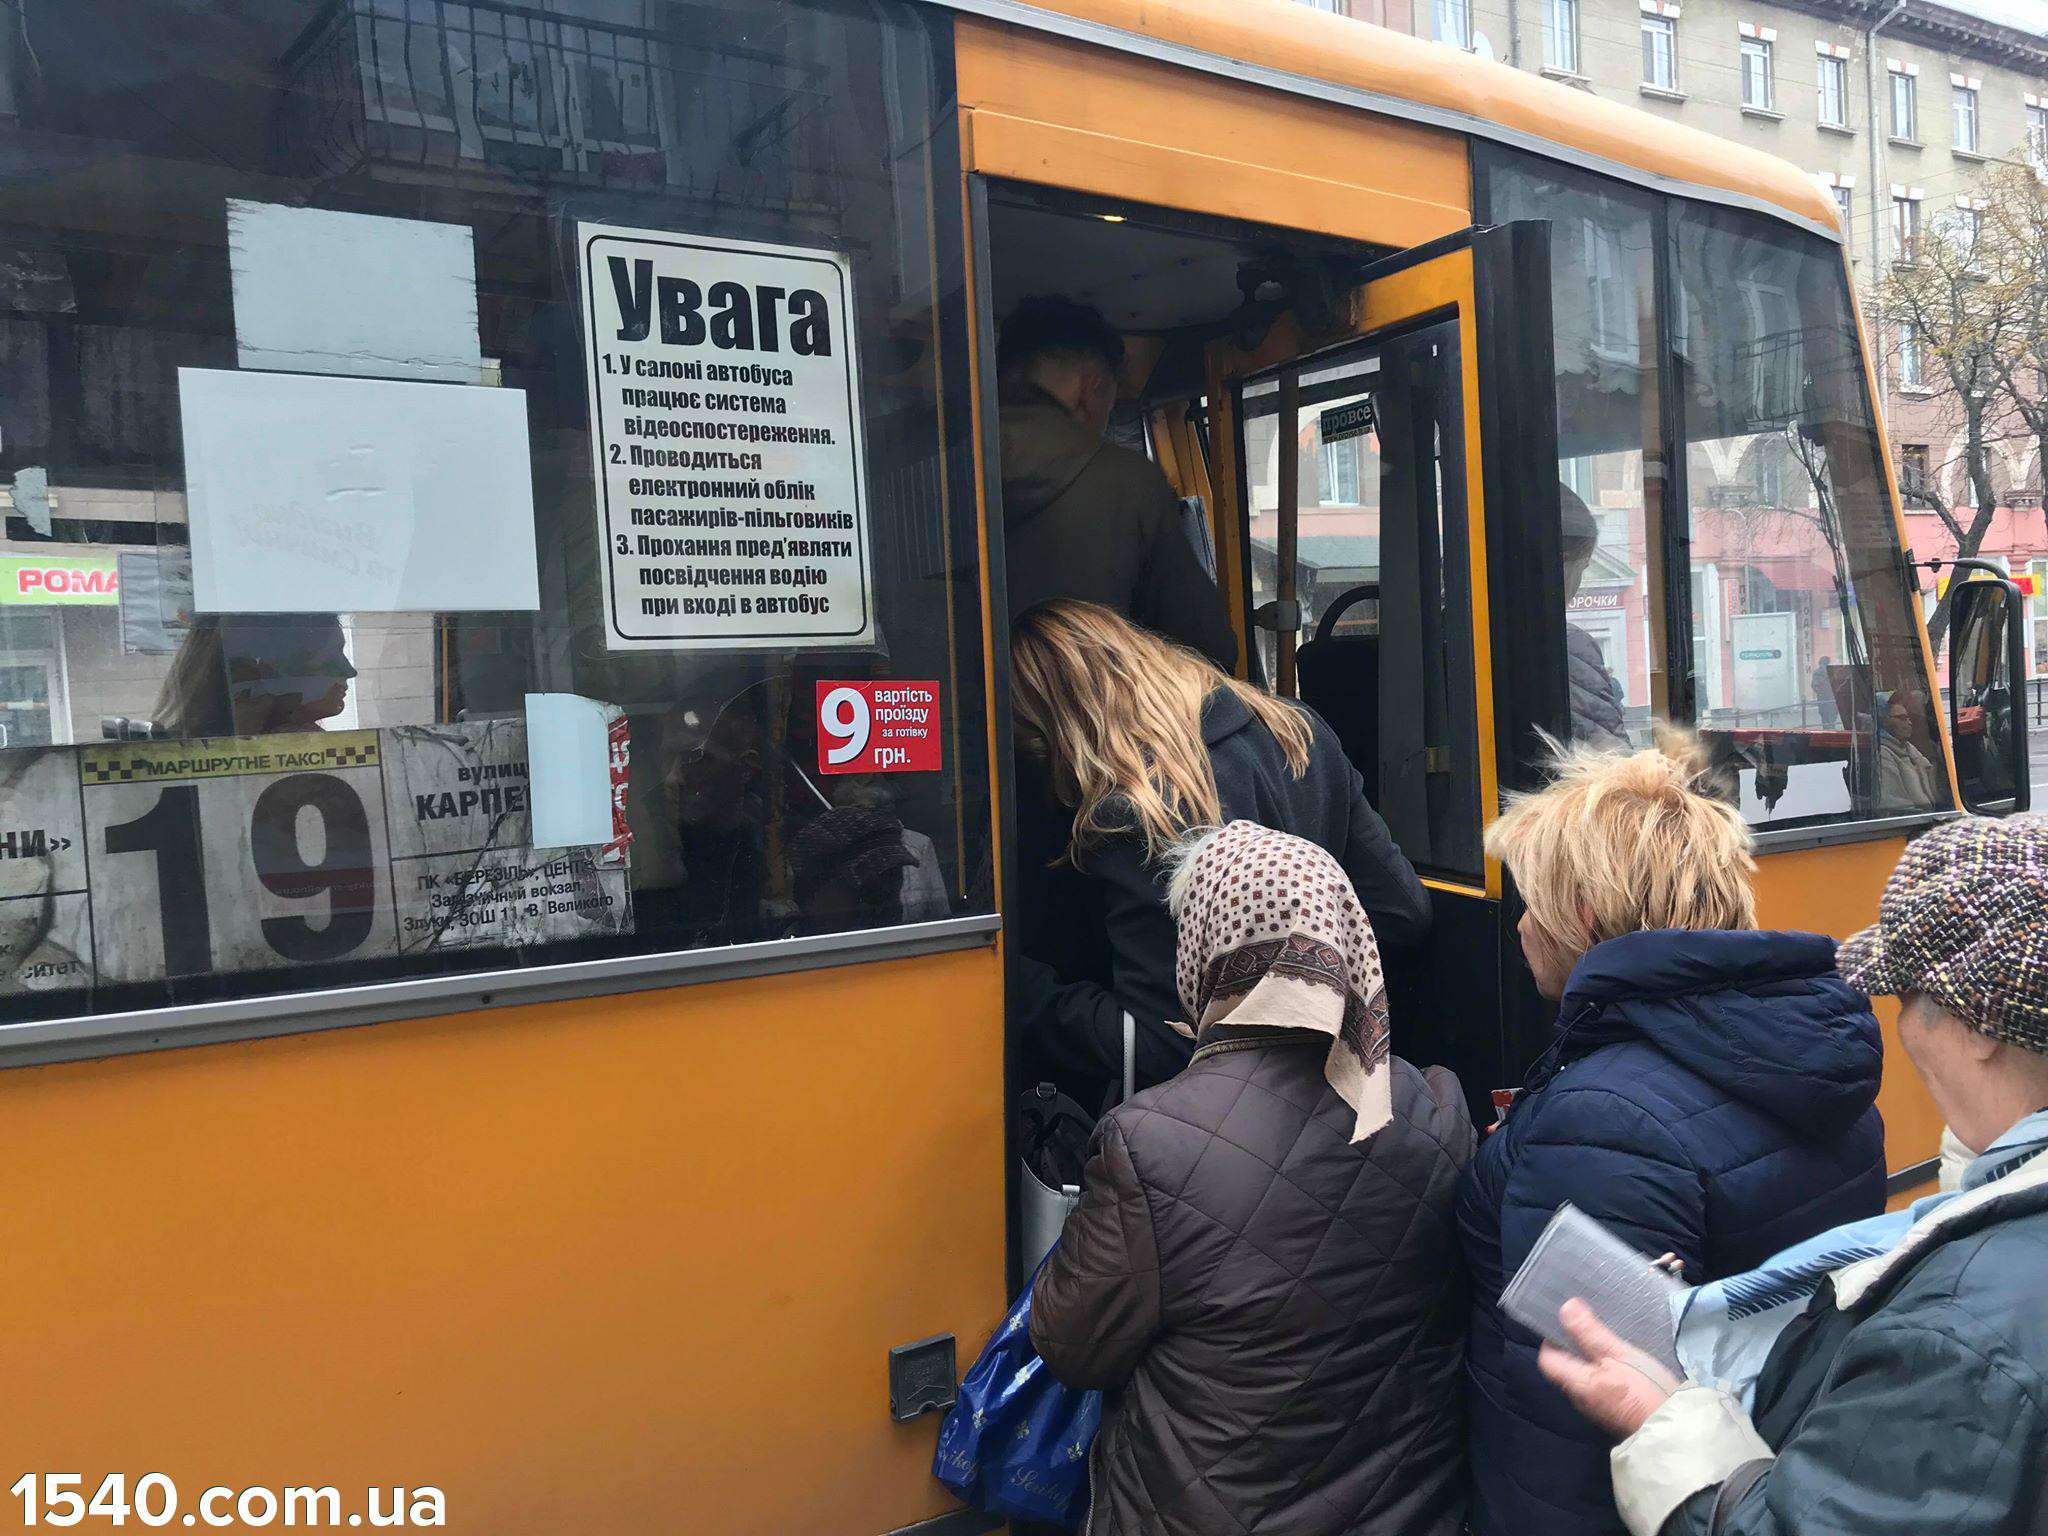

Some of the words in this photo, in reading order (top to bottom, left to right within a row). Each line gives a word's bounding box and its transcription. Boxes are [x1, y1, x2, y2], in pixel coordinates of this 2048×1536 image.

[606, 255, 832, 358] Увага
[602, 353, 617, 375] 1.
[620, 354, 631, 375] У
[636, 358, 703, 381] салоні
[706, 364, 794, 386] автобуса
[622, 387, 701, 411] працює
[706, 394, 787, 414] система
[624, 416, 836, 445] відеоспостереження.
[609, 443, 627, 465] 2.
[630, 444, 762, 471] Проводиться
[628, 477, 760, 500] електронний
[764, 480, 816, 501] облік
[630, 507, 854, 530] пасажирів-пільговиків
[616, 534, 634, 556] 3.
[637, 535, 732, 558] Прохання
[639, 565, 766, 588] посвідчення
[769, 567, 828, 588] водію
[641, 597, 679, 617] при
[684, 594, 737, 617] вході
[740, 597, 752, 614] в
[756, 593, 830, 616] автобус
[874, 687, 933, 706] вартість
[821, 687, 870, 765] 9
[875, 705, 929, 724] проїзду
[882, 728, 893, 737] за
[895, 726, 929, 739] готівку
[147, 755, 271, 776] МАРШРУТНЕ
[275, 751, 326, 768] ТАКСІ
[874, 747, 911, 769] грн.
[416, 783, 531, 822] КАРПЕ
[105, 772, 375, 978] 19
[460, 908, 496, 927] ЗОШ
[548, 895, 614, 914] Великого
